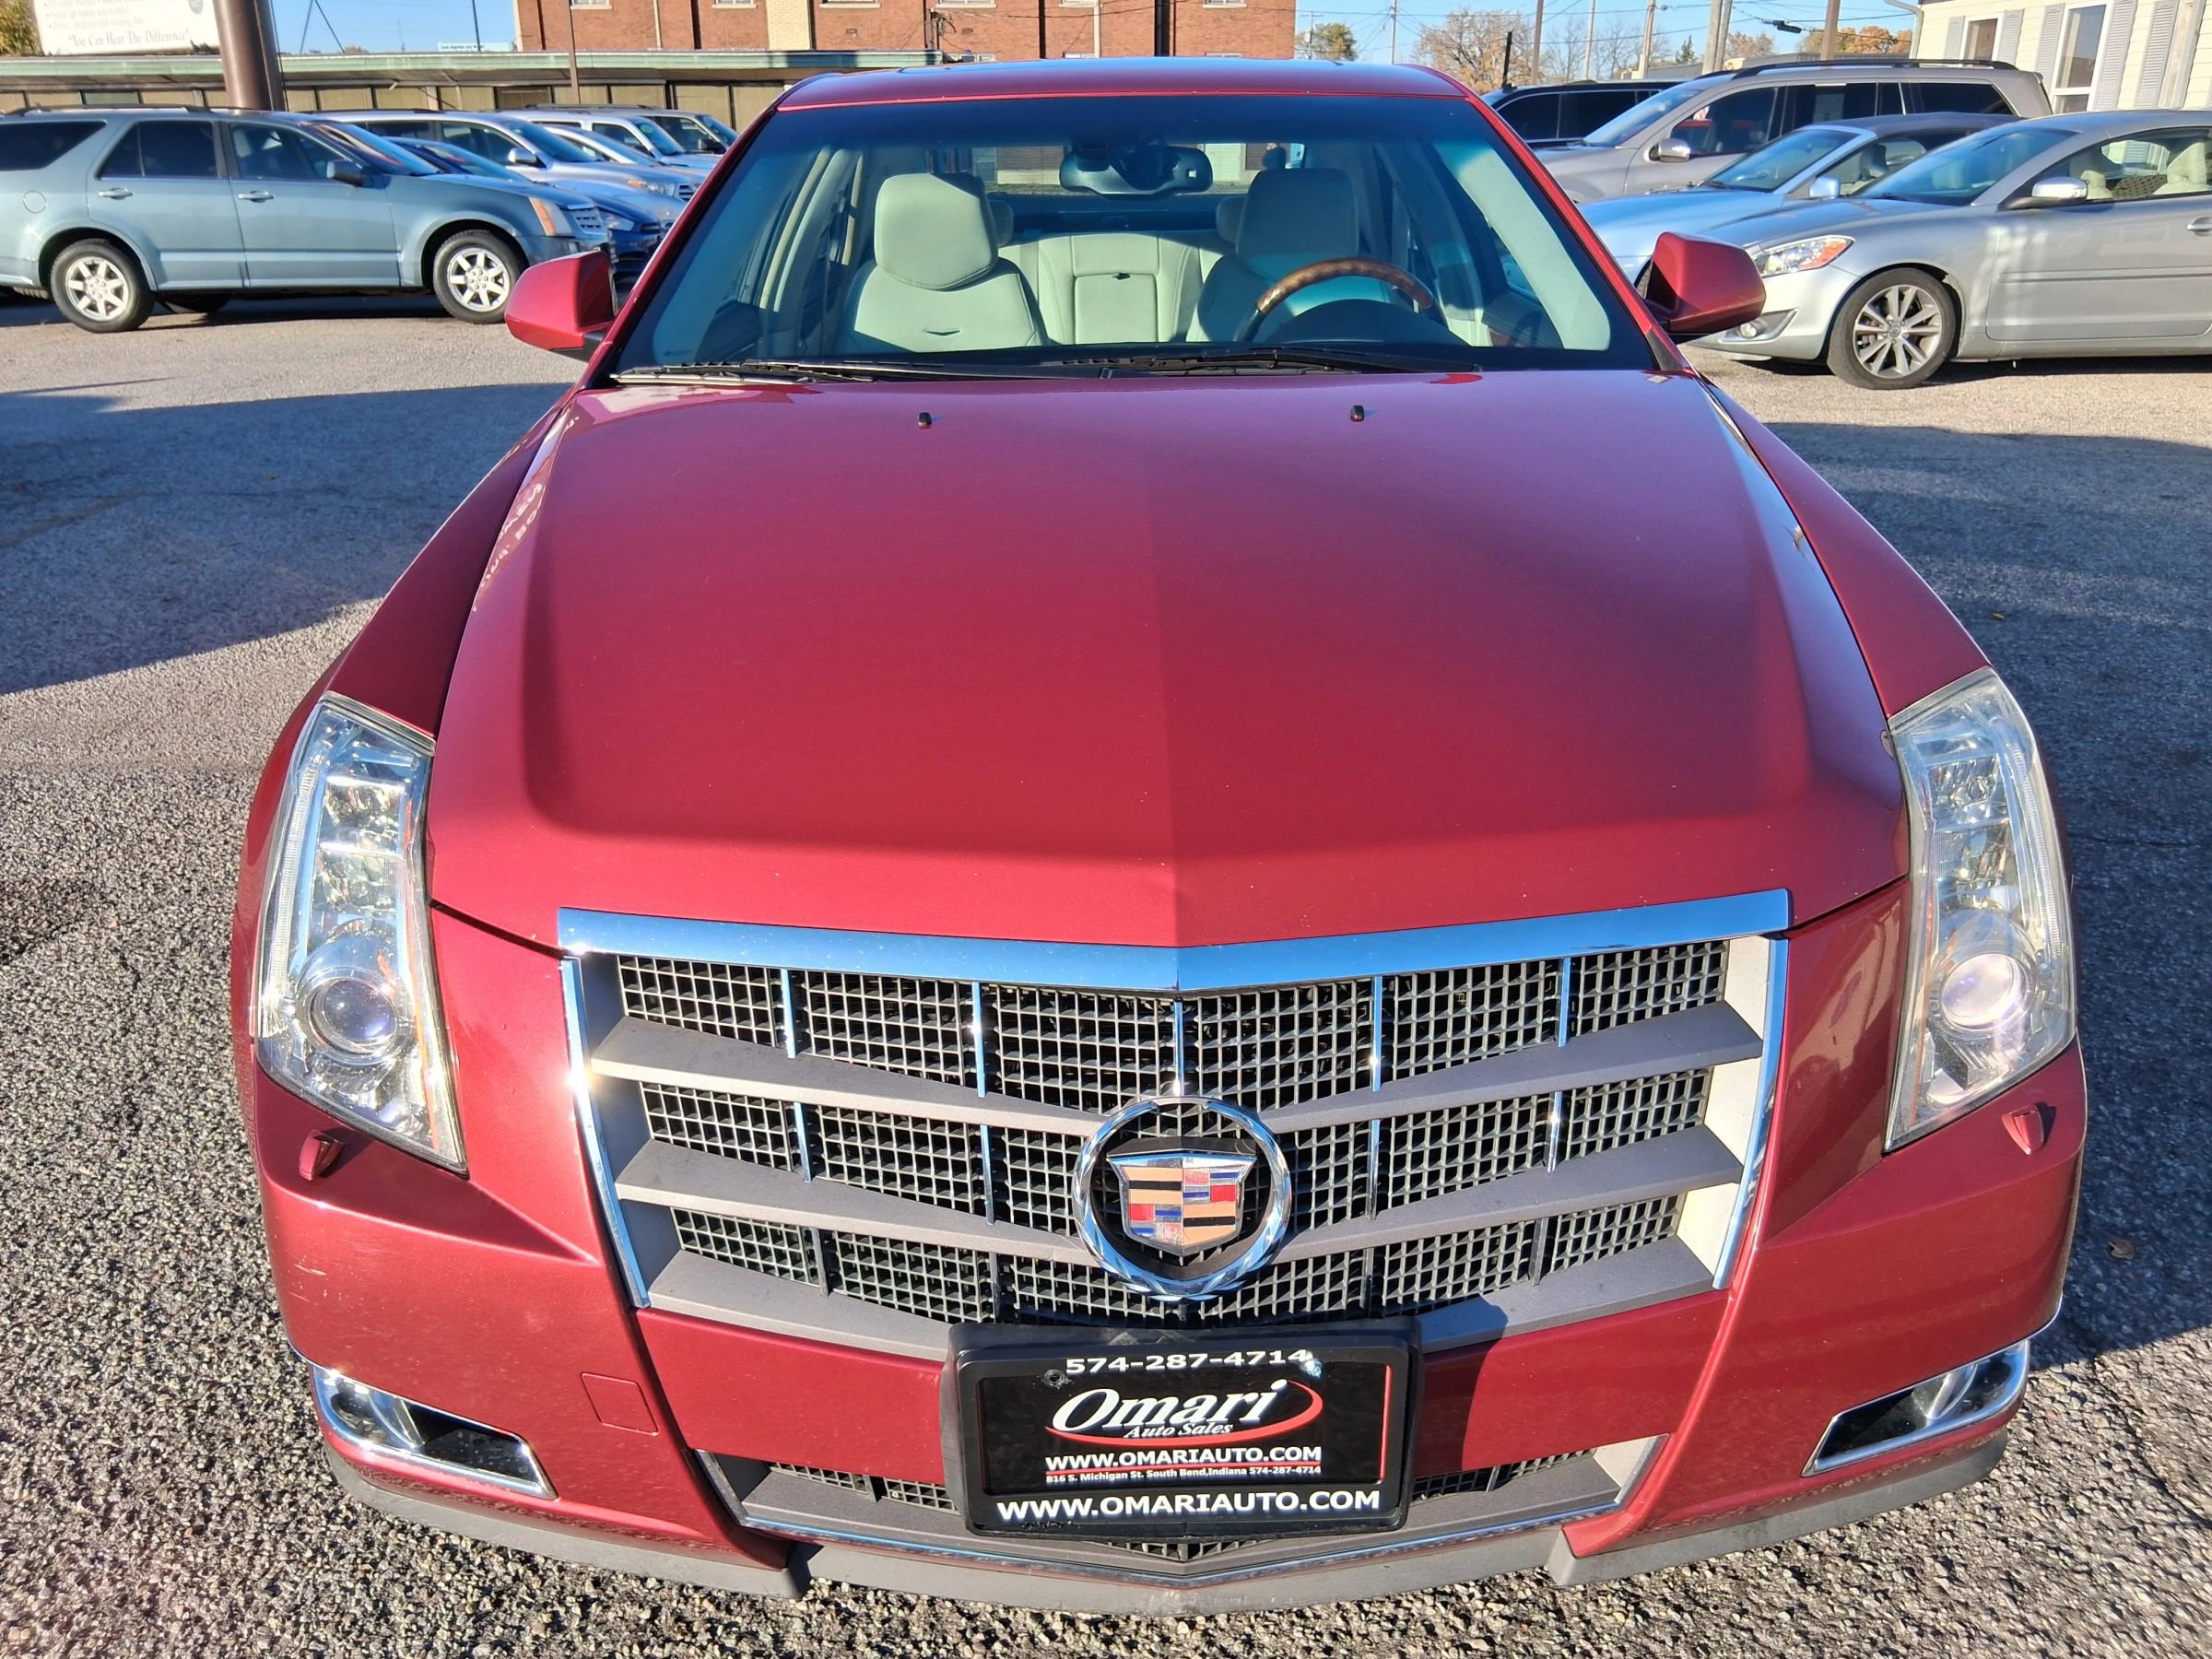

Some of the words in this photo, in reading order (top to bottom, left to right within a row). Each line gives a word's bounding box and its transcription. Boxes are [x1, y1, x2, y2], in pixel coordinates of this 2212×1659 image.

[88, 34, 103, 46] Can
[106, 31, 124, 45] Hear
[127, 29, 141, 43] The
[1066, 1349, 1313, 1374] 574-287-4714
[1052, 1379, 1288, 1431] Omari
[1124, 1425, 1177, 1439] Auto
[1177, 1421, 1233, 1435] Sales
[1045, 1446, 1322, 1471] WWW.OMARIAUTO.COM
[1045, 1475, 1066, 1483] 816
[1067, 1474, 1078, 1482] S.
[1080, 1472, 1128, 1482] Michigan
[1130, 1470, 1145, 1478] St.
[1147, 1468, 1177, 1477] South
[1249, 1465, 1322, 1475] 574-287-4714
[996, 1489, 1381, 1521] WWW.OMARIAUTO.COM
